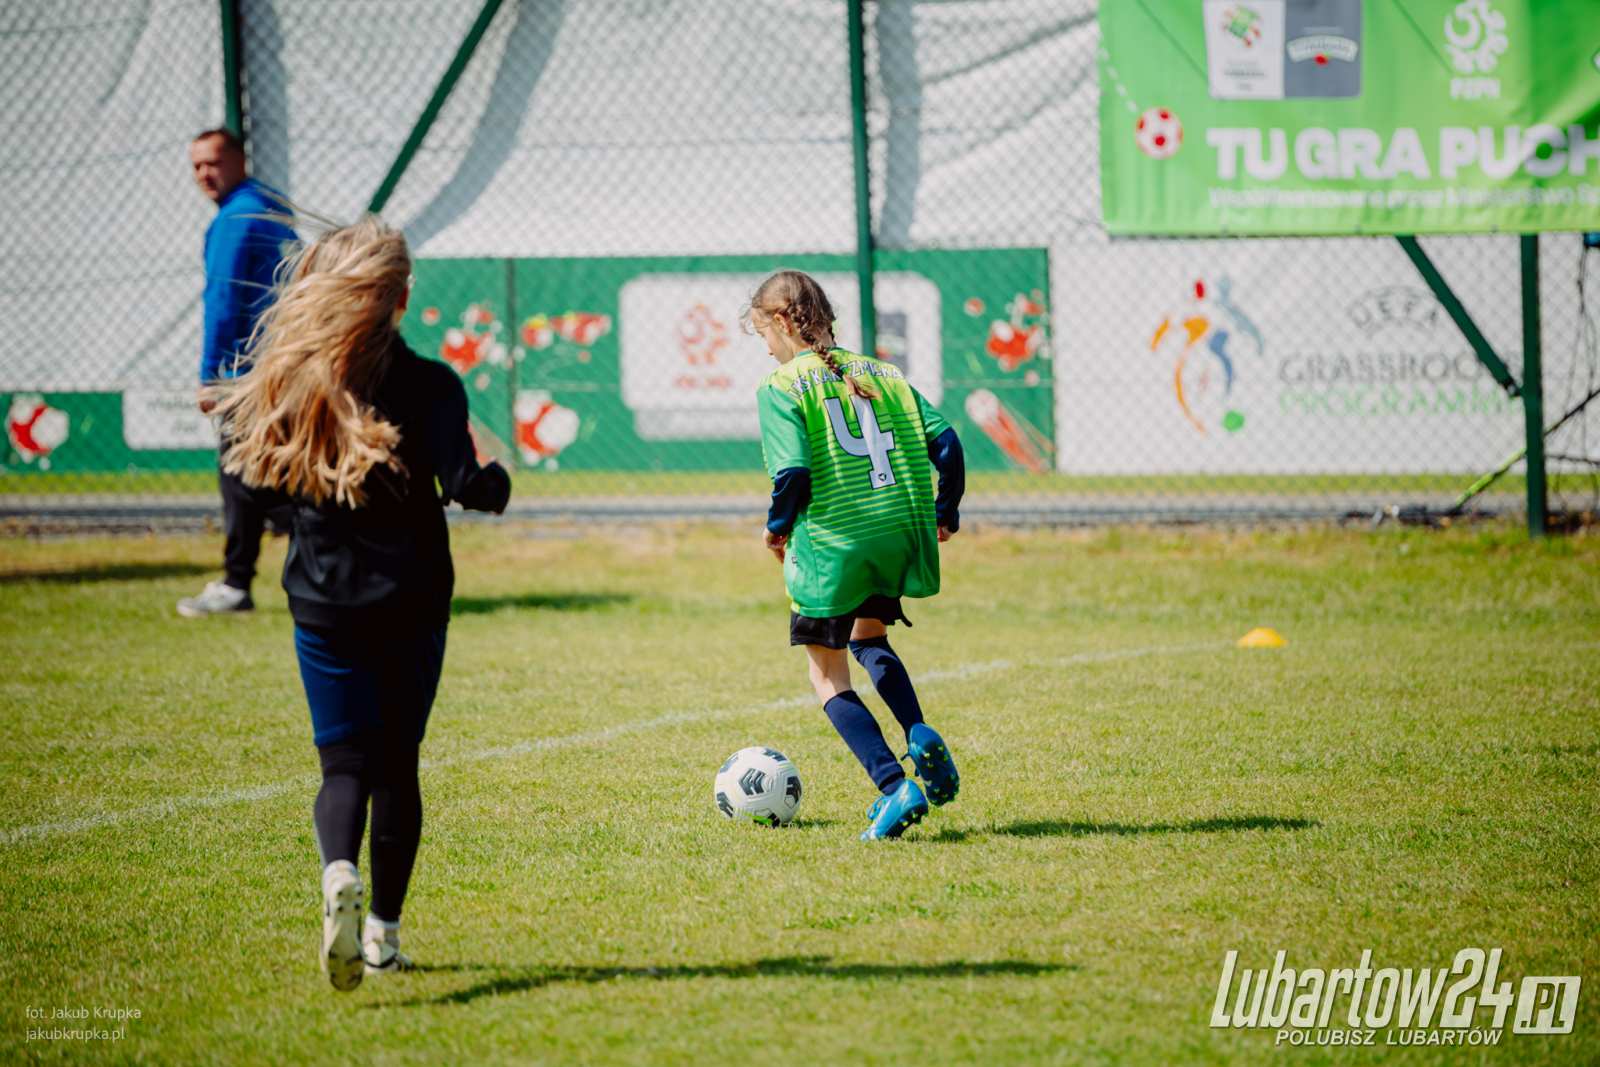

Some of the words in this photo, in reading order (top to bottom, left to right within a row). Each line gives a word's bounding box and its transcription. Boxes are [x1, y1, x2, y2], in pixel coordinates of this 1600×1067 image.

[1206, 127, 1287, 180] TU
[1294, 126, 1431, 180] GRA
[1439, 123, 1600, 180] PUCH
[823, 396, 896, 490] 4
